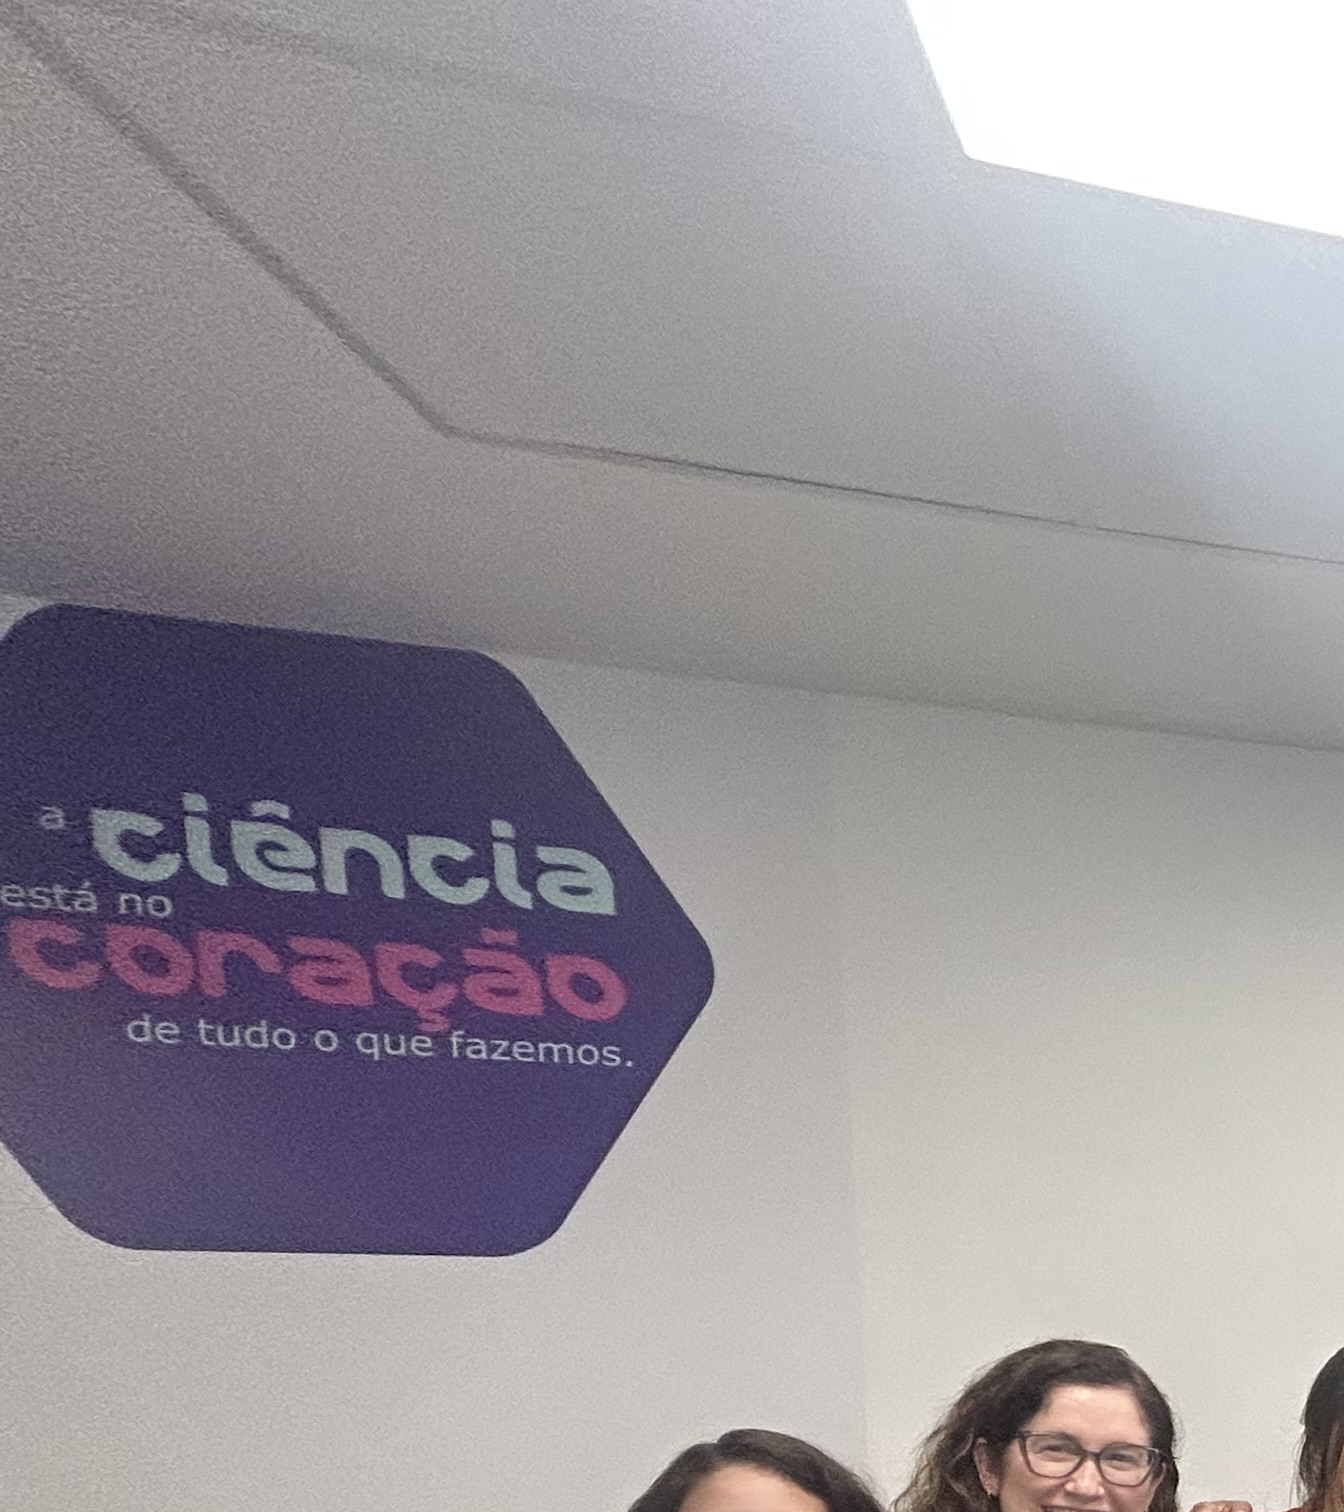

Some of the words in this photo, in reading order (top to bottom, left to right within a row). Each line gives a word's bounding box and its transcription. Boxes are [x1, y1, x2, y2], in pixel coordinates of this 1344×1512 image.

[38, 805, 65, 829] a
[91, 792, 617, 915] ciência
[0, 881, 98, 913] está
[117, 893, 173, 917] no
[8, 918, 628, 1031] coração
[126, 1014, 181, 1044] de
[198, 1018, 297, 1050] tudo
[314, 1029, 338, 1053] o
[356, 1032, 434, 1060] que
[451, 1031, 634, 1068] fazemos.
